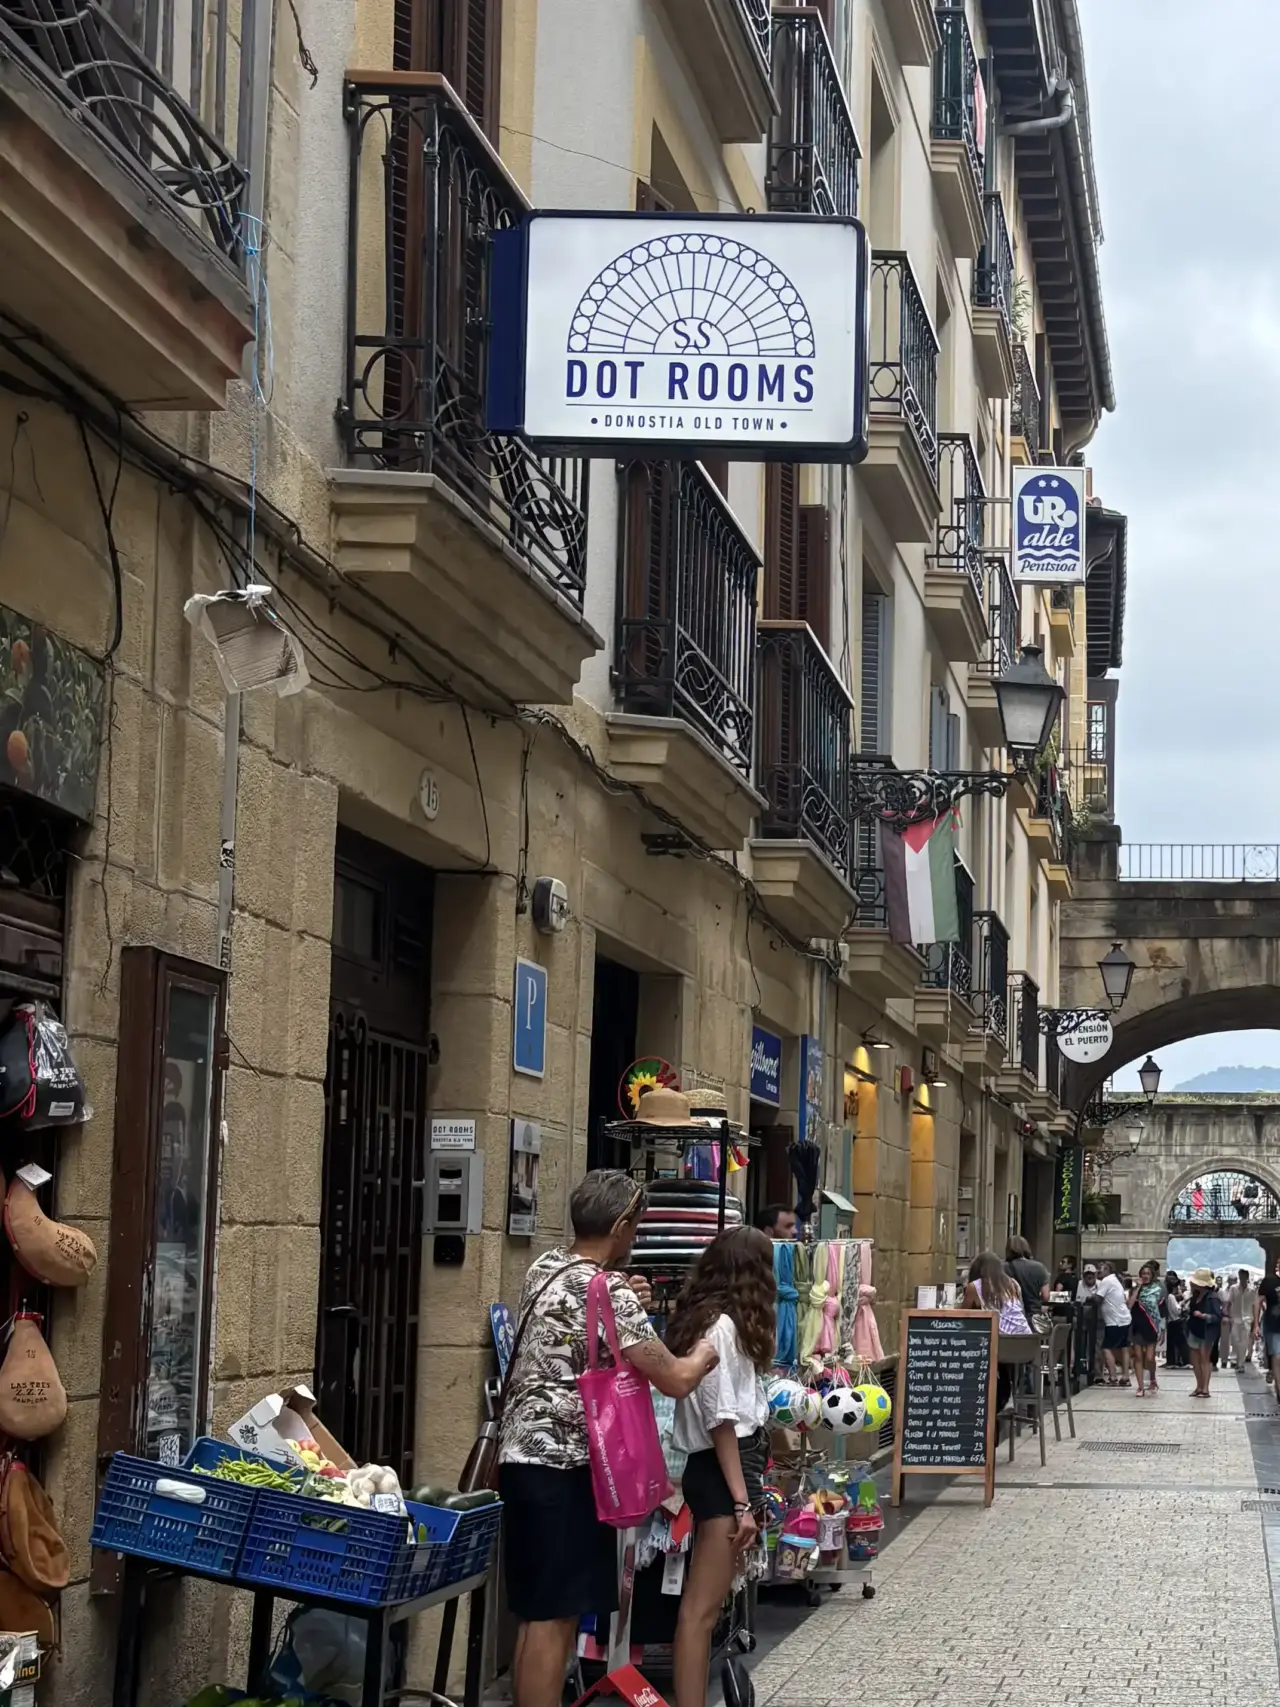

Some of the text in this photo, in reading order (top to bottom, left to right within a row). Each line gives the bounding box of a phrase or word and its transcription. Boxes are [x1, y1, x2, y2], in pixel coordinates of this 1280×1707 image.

[566, 359, 814, 403] DOT ROOMS
[604, 415, 774, 431] DONOSTIA OLD TOWN
[1020, 495, 1078, 528] UR
[1023, 525, 1075, 547] alde
[1020, 559, 1076, 573] Pentsioa
[526, 976, 537, 1030] P
[1065, 1035, 1109, 1046] EL PUERTO
[433, 1126, 473, 1134] DOT ROOMS
[28, 1381, 51, 1389] TRES
